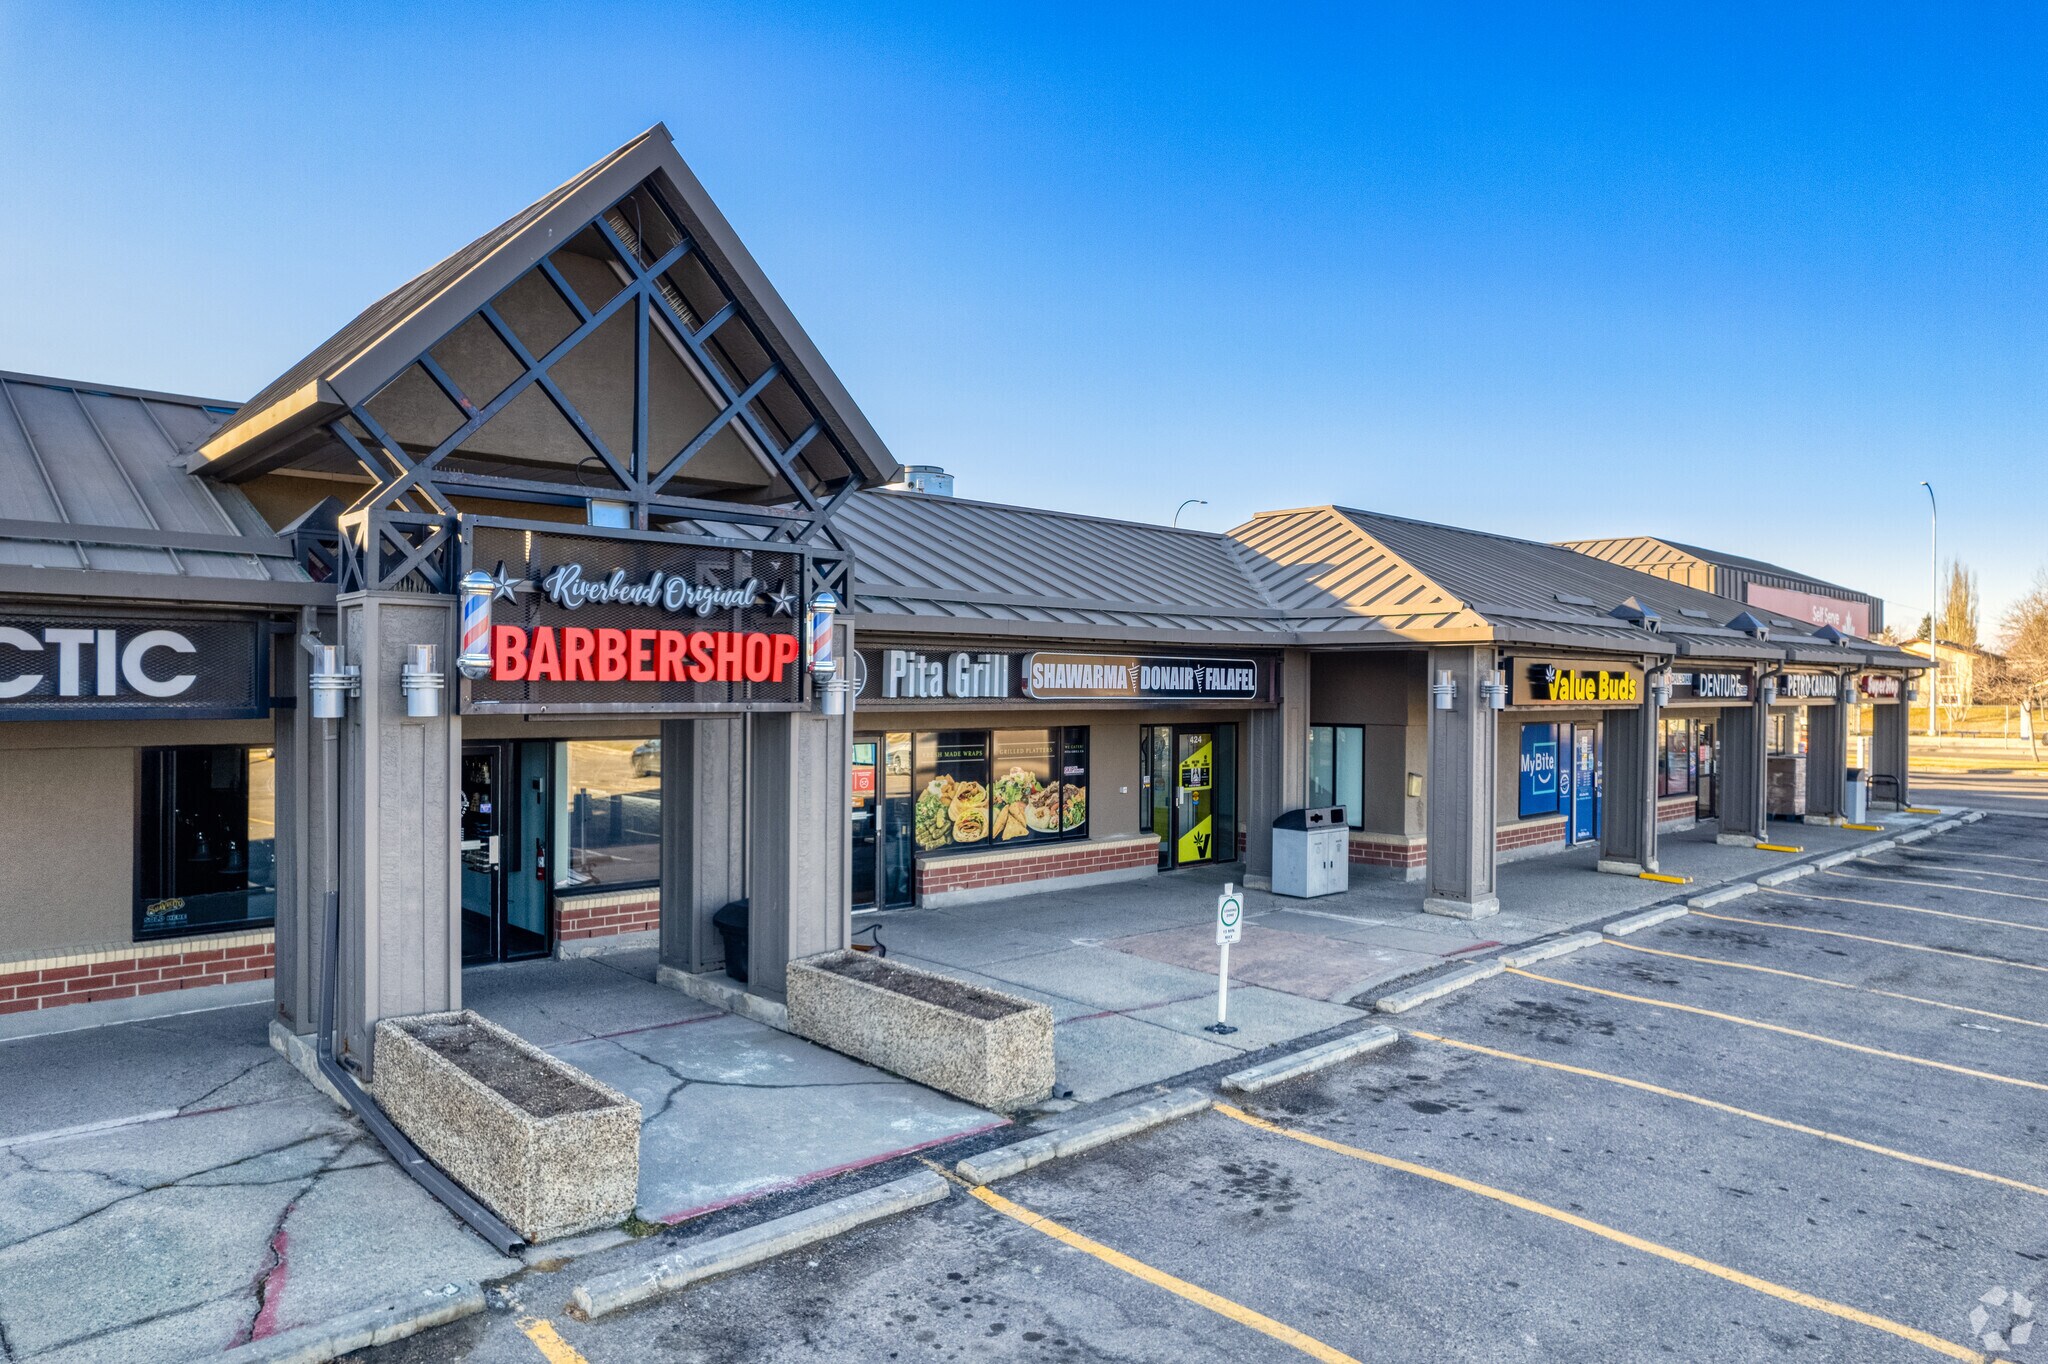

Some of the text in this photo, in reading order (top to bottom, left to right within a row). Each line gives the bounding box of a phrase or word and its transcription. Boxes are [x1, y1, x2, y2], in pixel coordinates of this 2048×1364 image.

[544, 563, 758, 618] Riverbend Original
[1813, 605, 1840, 625] Self Serve
[493, 625, 799, 683] BARBERSHOP
[884, 650, 1009, 698] Pita Grill
[1032, 662, 1255, 691] SHAWARMA DONAIR FALAFEL
[1548, 669, 1637, 701] Value Buds
[1700, 673, 1742, 697] DENTURE
[1026, 746, 1053, 755] PLATTERS
[1189, 735, 1202, 744] 424
[944, 750, 961, 758] MADE
[1521, 752, 1555, 777] MyBite
